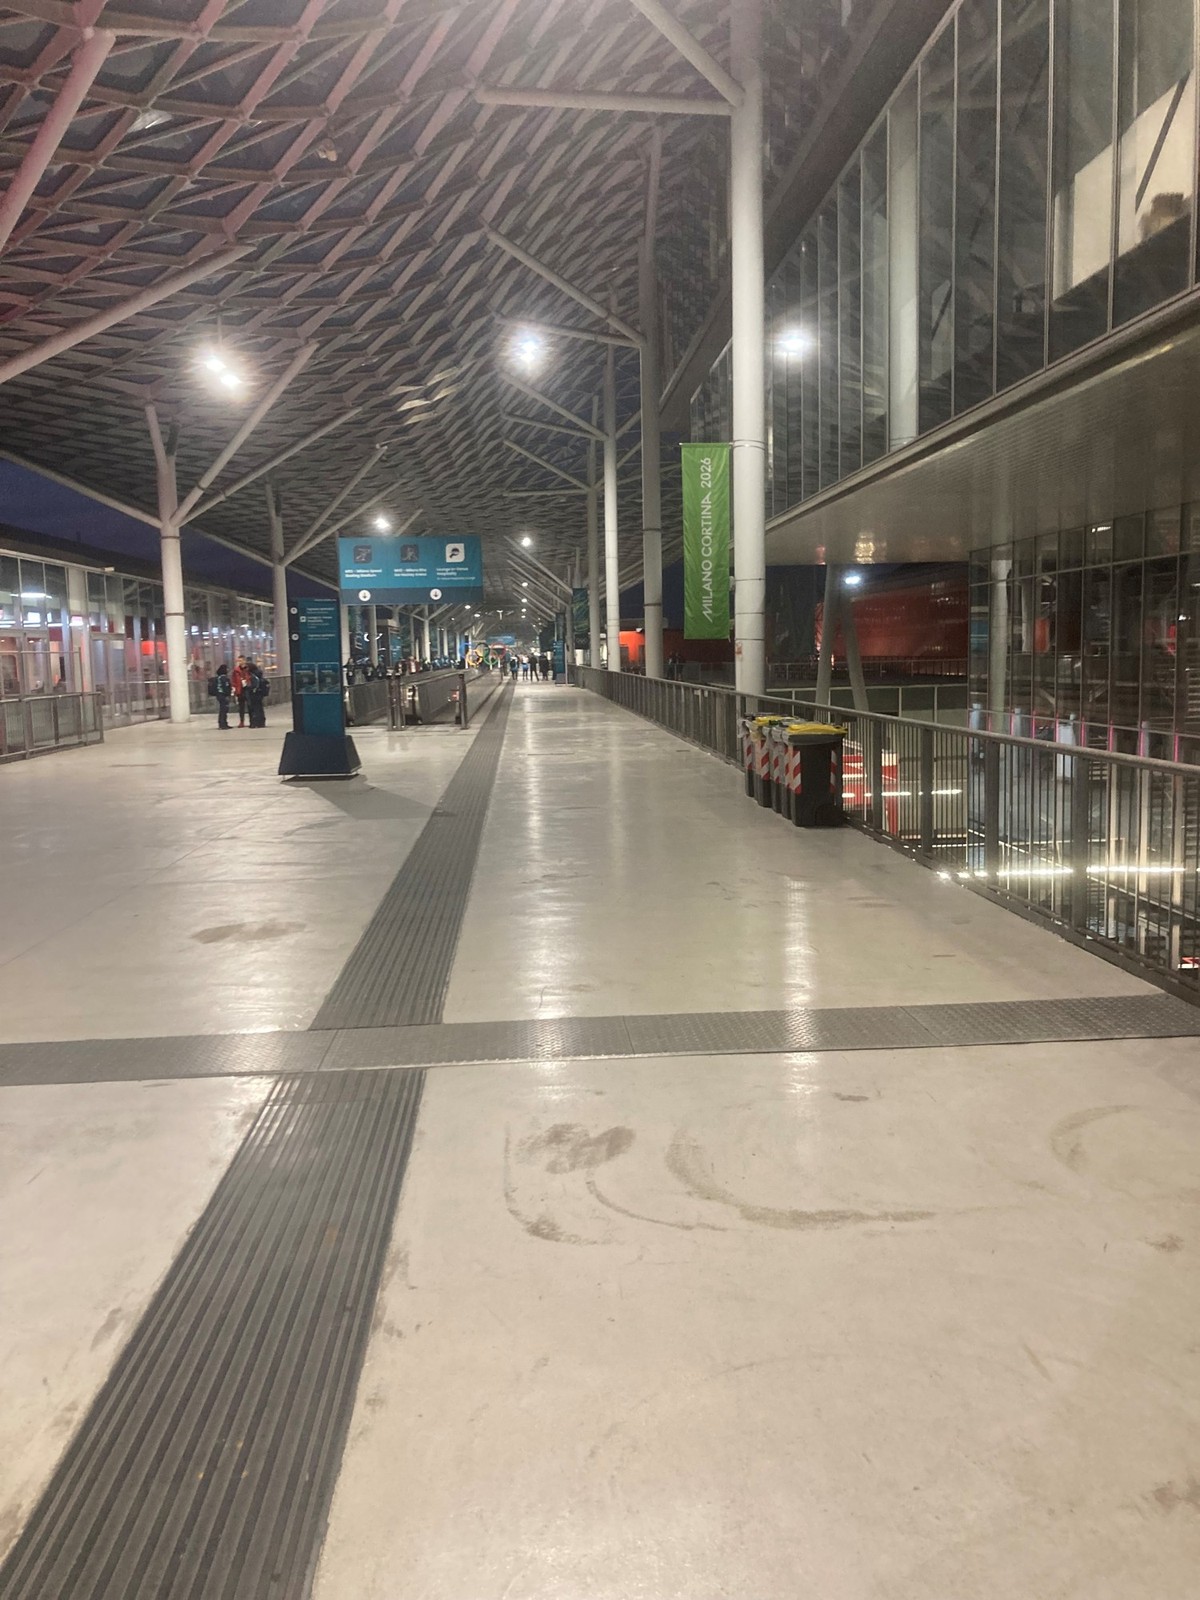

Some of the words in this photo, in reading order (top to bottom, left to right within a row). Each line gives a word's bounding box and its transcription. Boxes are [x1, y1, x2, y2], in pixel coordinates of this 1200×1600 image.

[700, 457, 712, 488] 2026
[701, 491, 712, 557] CORTINA
[701, 560, 713, 623] MILANO
